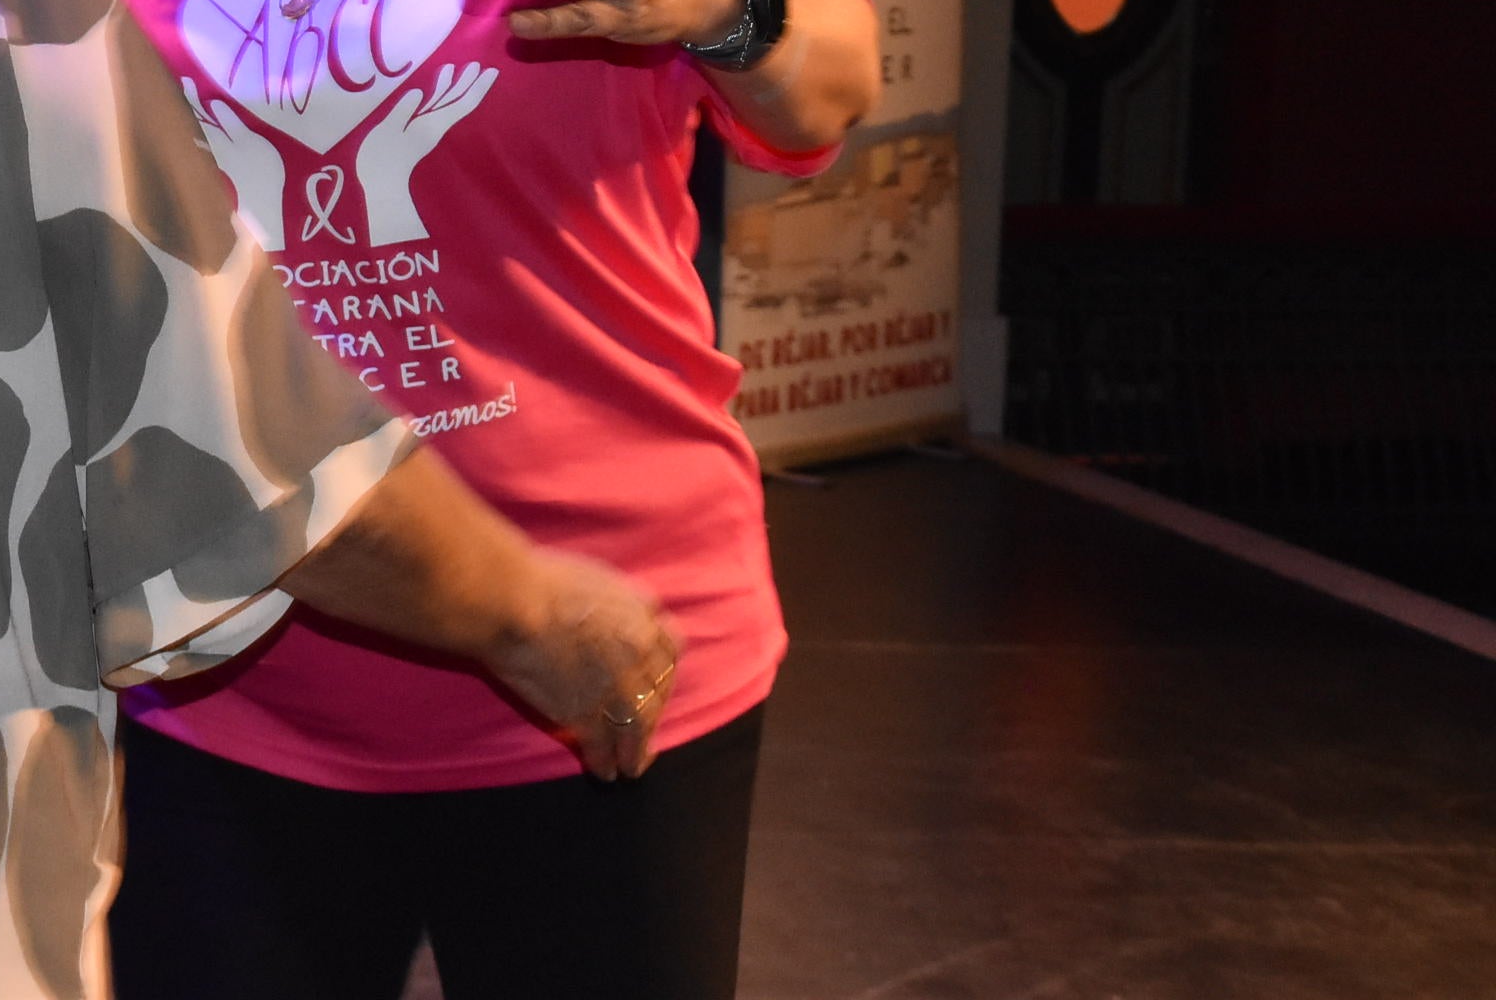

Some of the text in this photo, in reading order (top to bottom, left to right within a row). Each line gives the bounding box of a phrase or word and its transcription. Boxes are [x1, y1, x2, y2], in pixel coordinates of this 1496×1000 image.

[272, 249, 441, 288] OCIACIÓN
[294, 286, 445, 326] ARANA
[312, 324, 455, 358] TRA EL
[410, 381, 518, 438] zamos!
